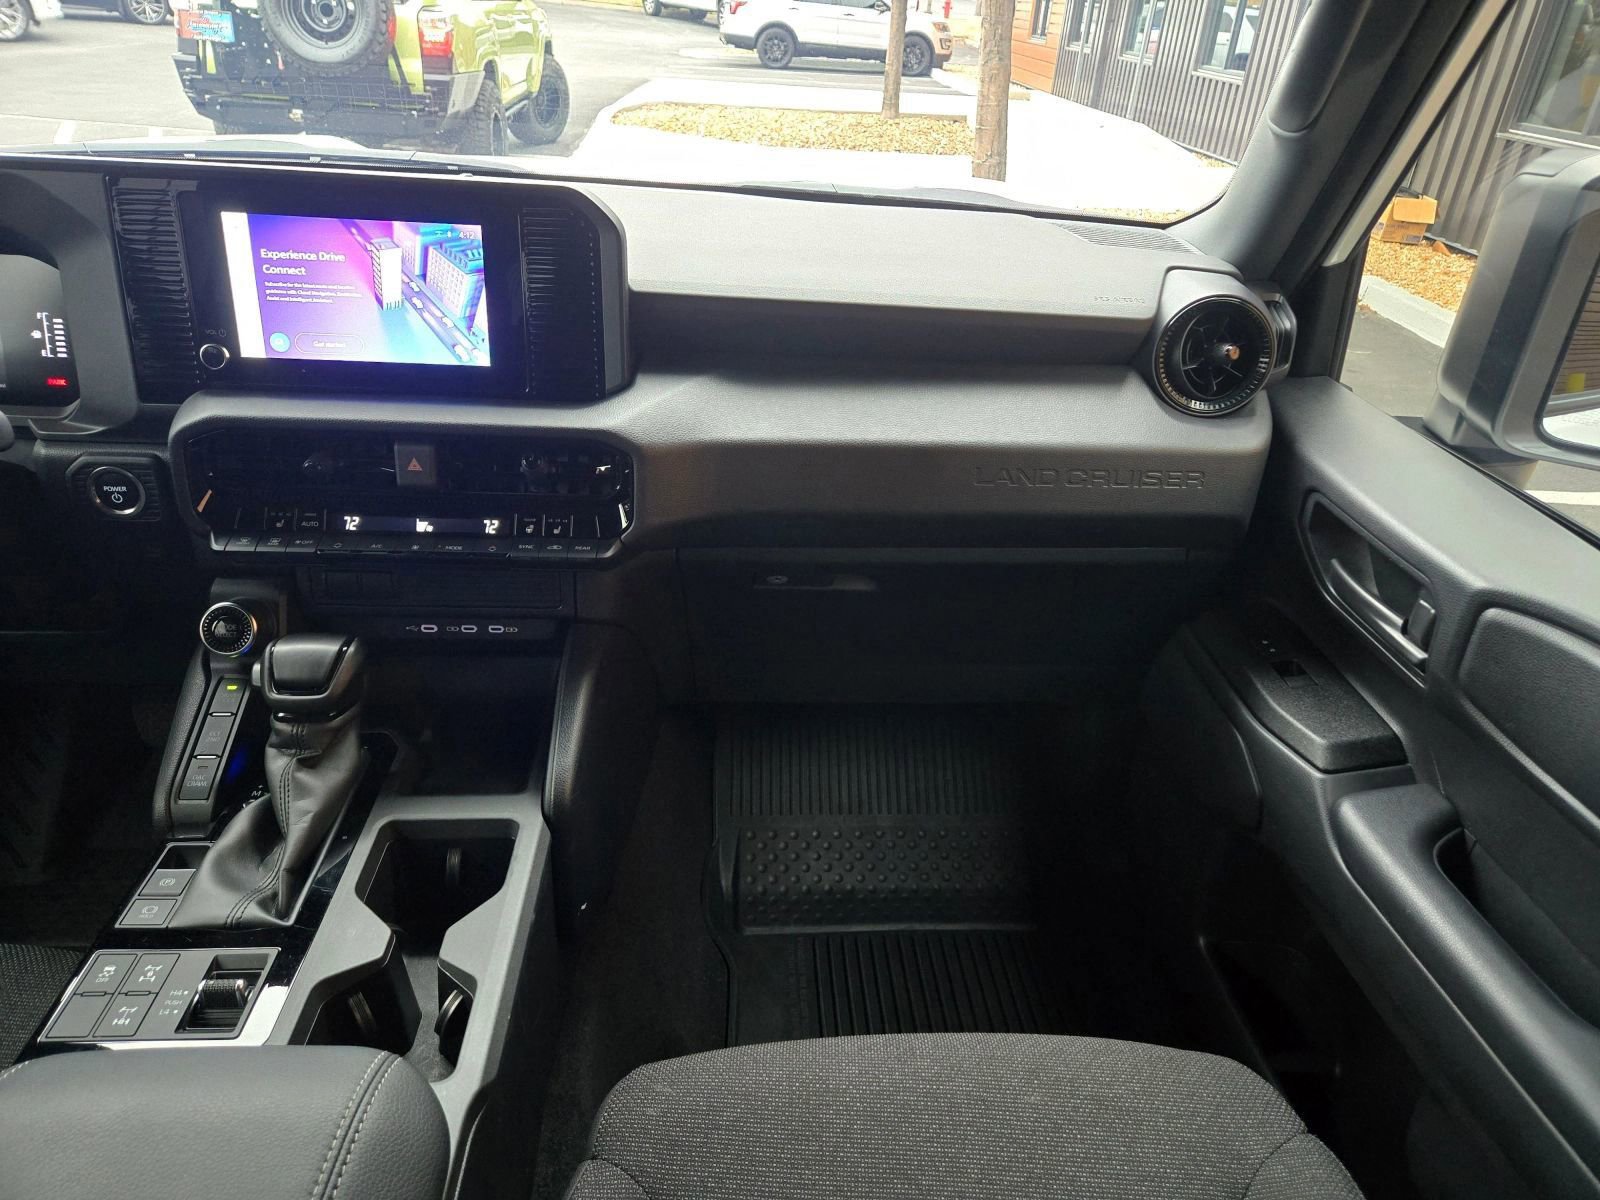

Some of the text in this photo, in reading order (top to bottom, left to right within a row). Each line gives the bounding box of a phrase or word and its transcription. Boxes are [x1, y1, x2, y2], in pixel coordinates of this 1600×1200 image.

[458, 231, 475, 239] 4:12
[260, 248, 346, 262] Experience Drive
[262, 264, 306, 275] Connect
[974, 467, 1206, 489] LAND CRUISER
[300, 520, 319, 528] AUTO
[343, 515, 360, 531] 72
[483, 519, 500, 534] 72
